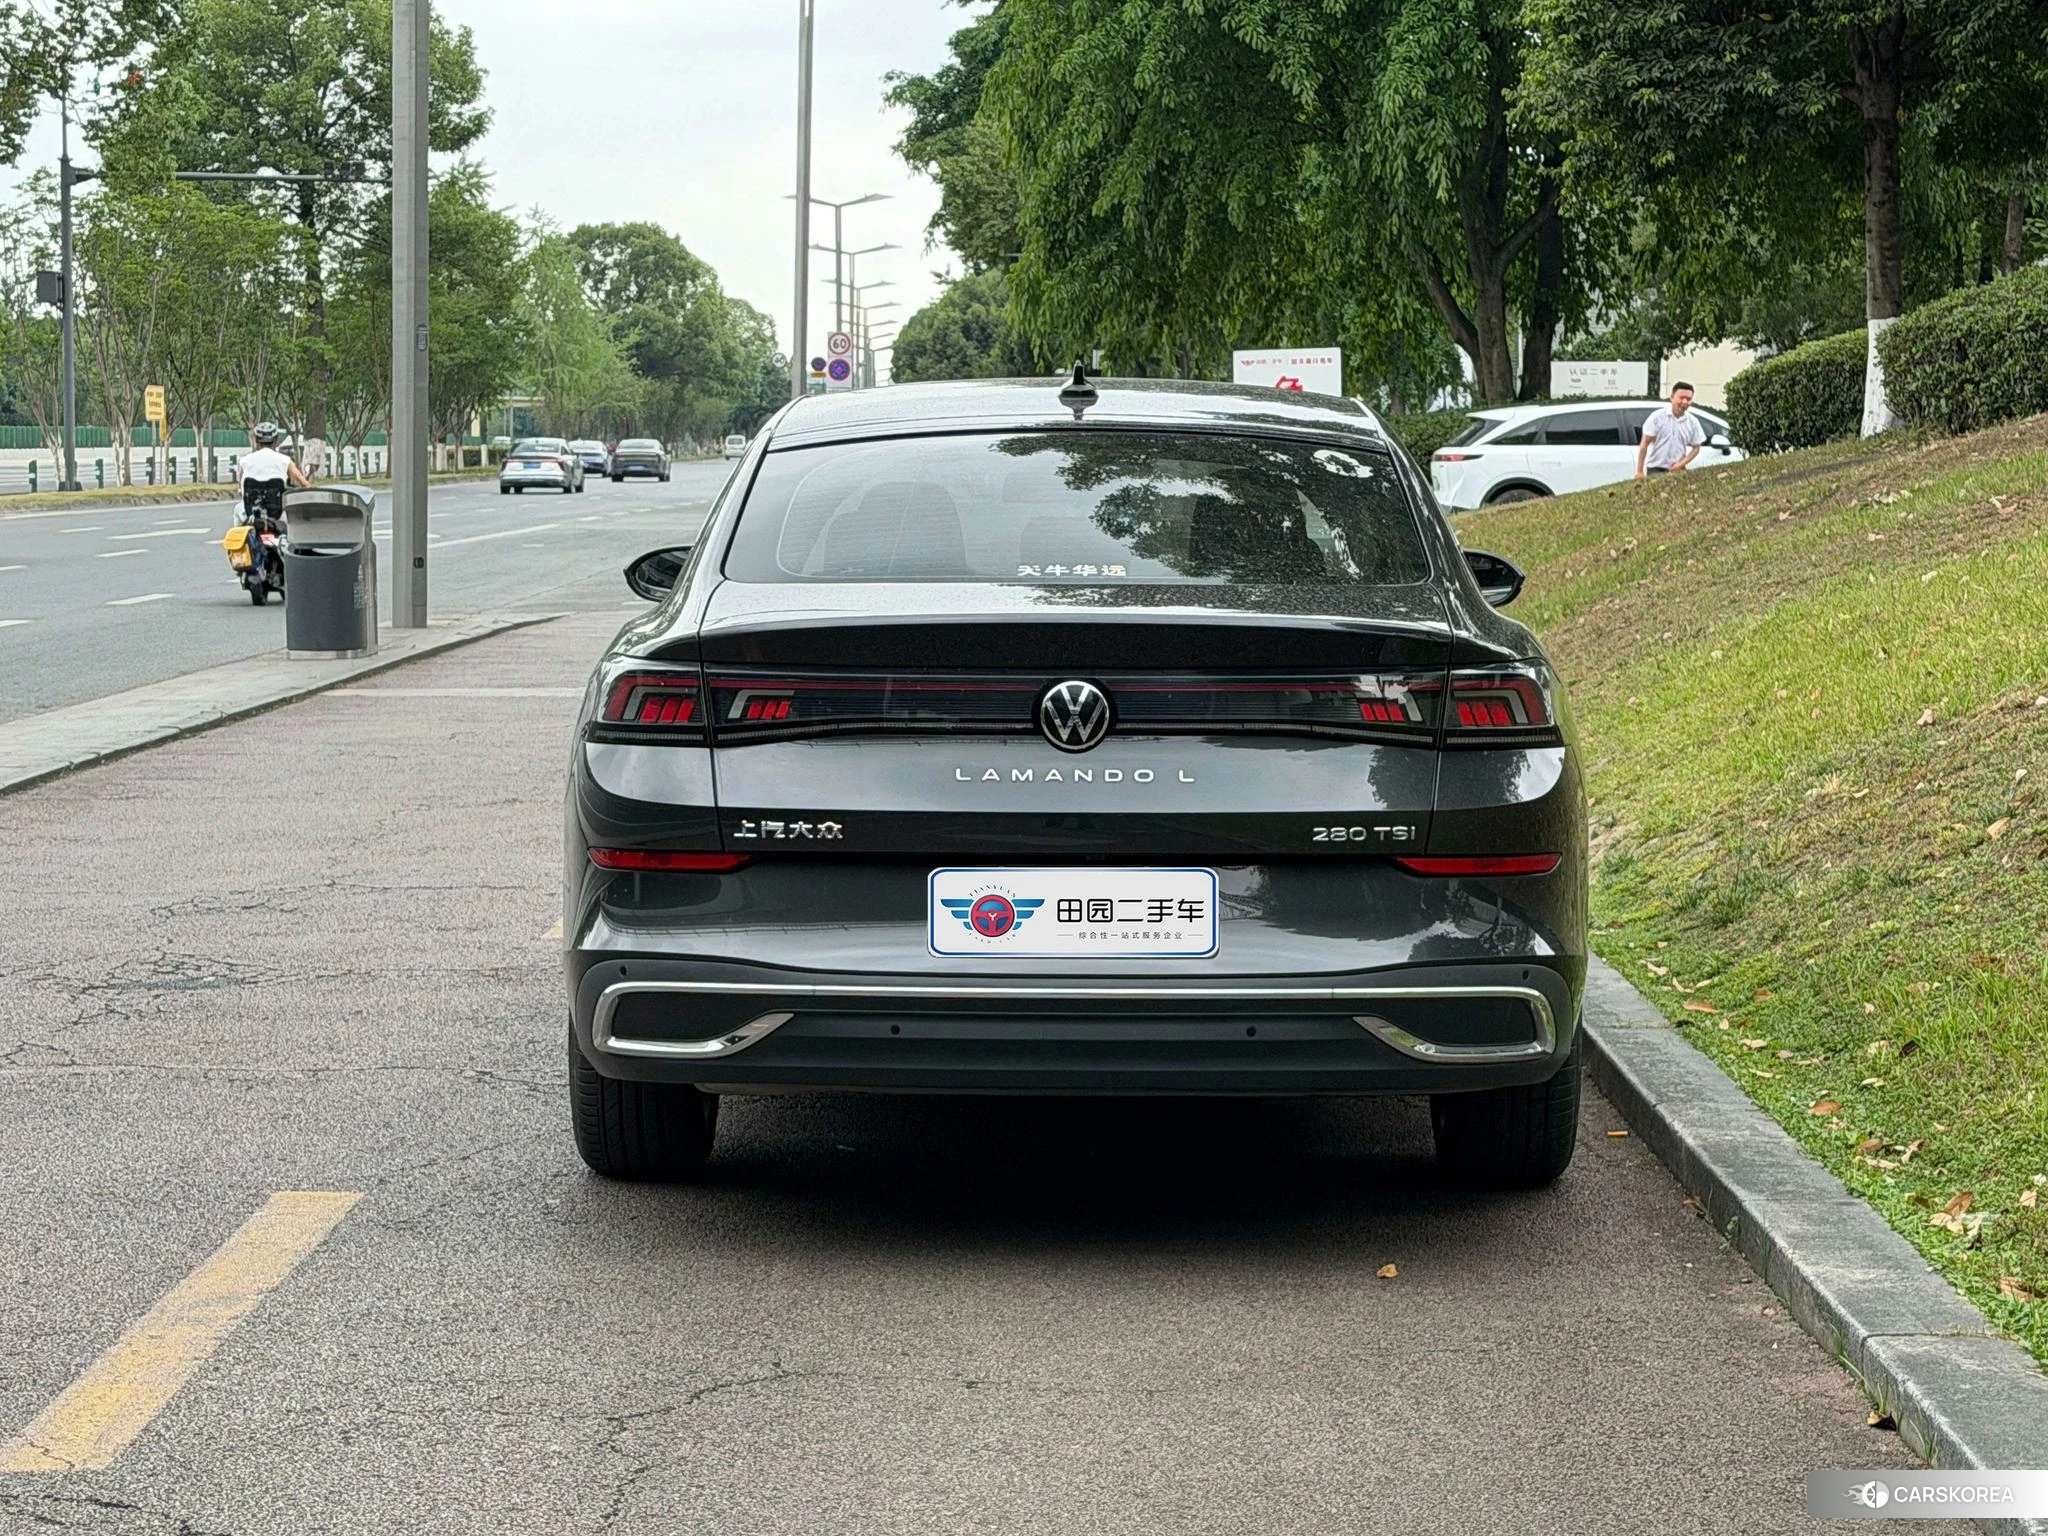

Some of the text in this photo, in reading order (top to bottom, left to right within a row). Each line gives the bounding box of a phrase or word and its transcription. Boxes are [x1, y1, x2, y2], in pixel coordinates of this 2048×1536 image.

[833, 338, 847, 349] 60
[955, 767, 1195, 783] LAMANDO L
[733, 819, 843, 839] 上汽大众
[1312, 826, 1416, 841] 280 TSI
